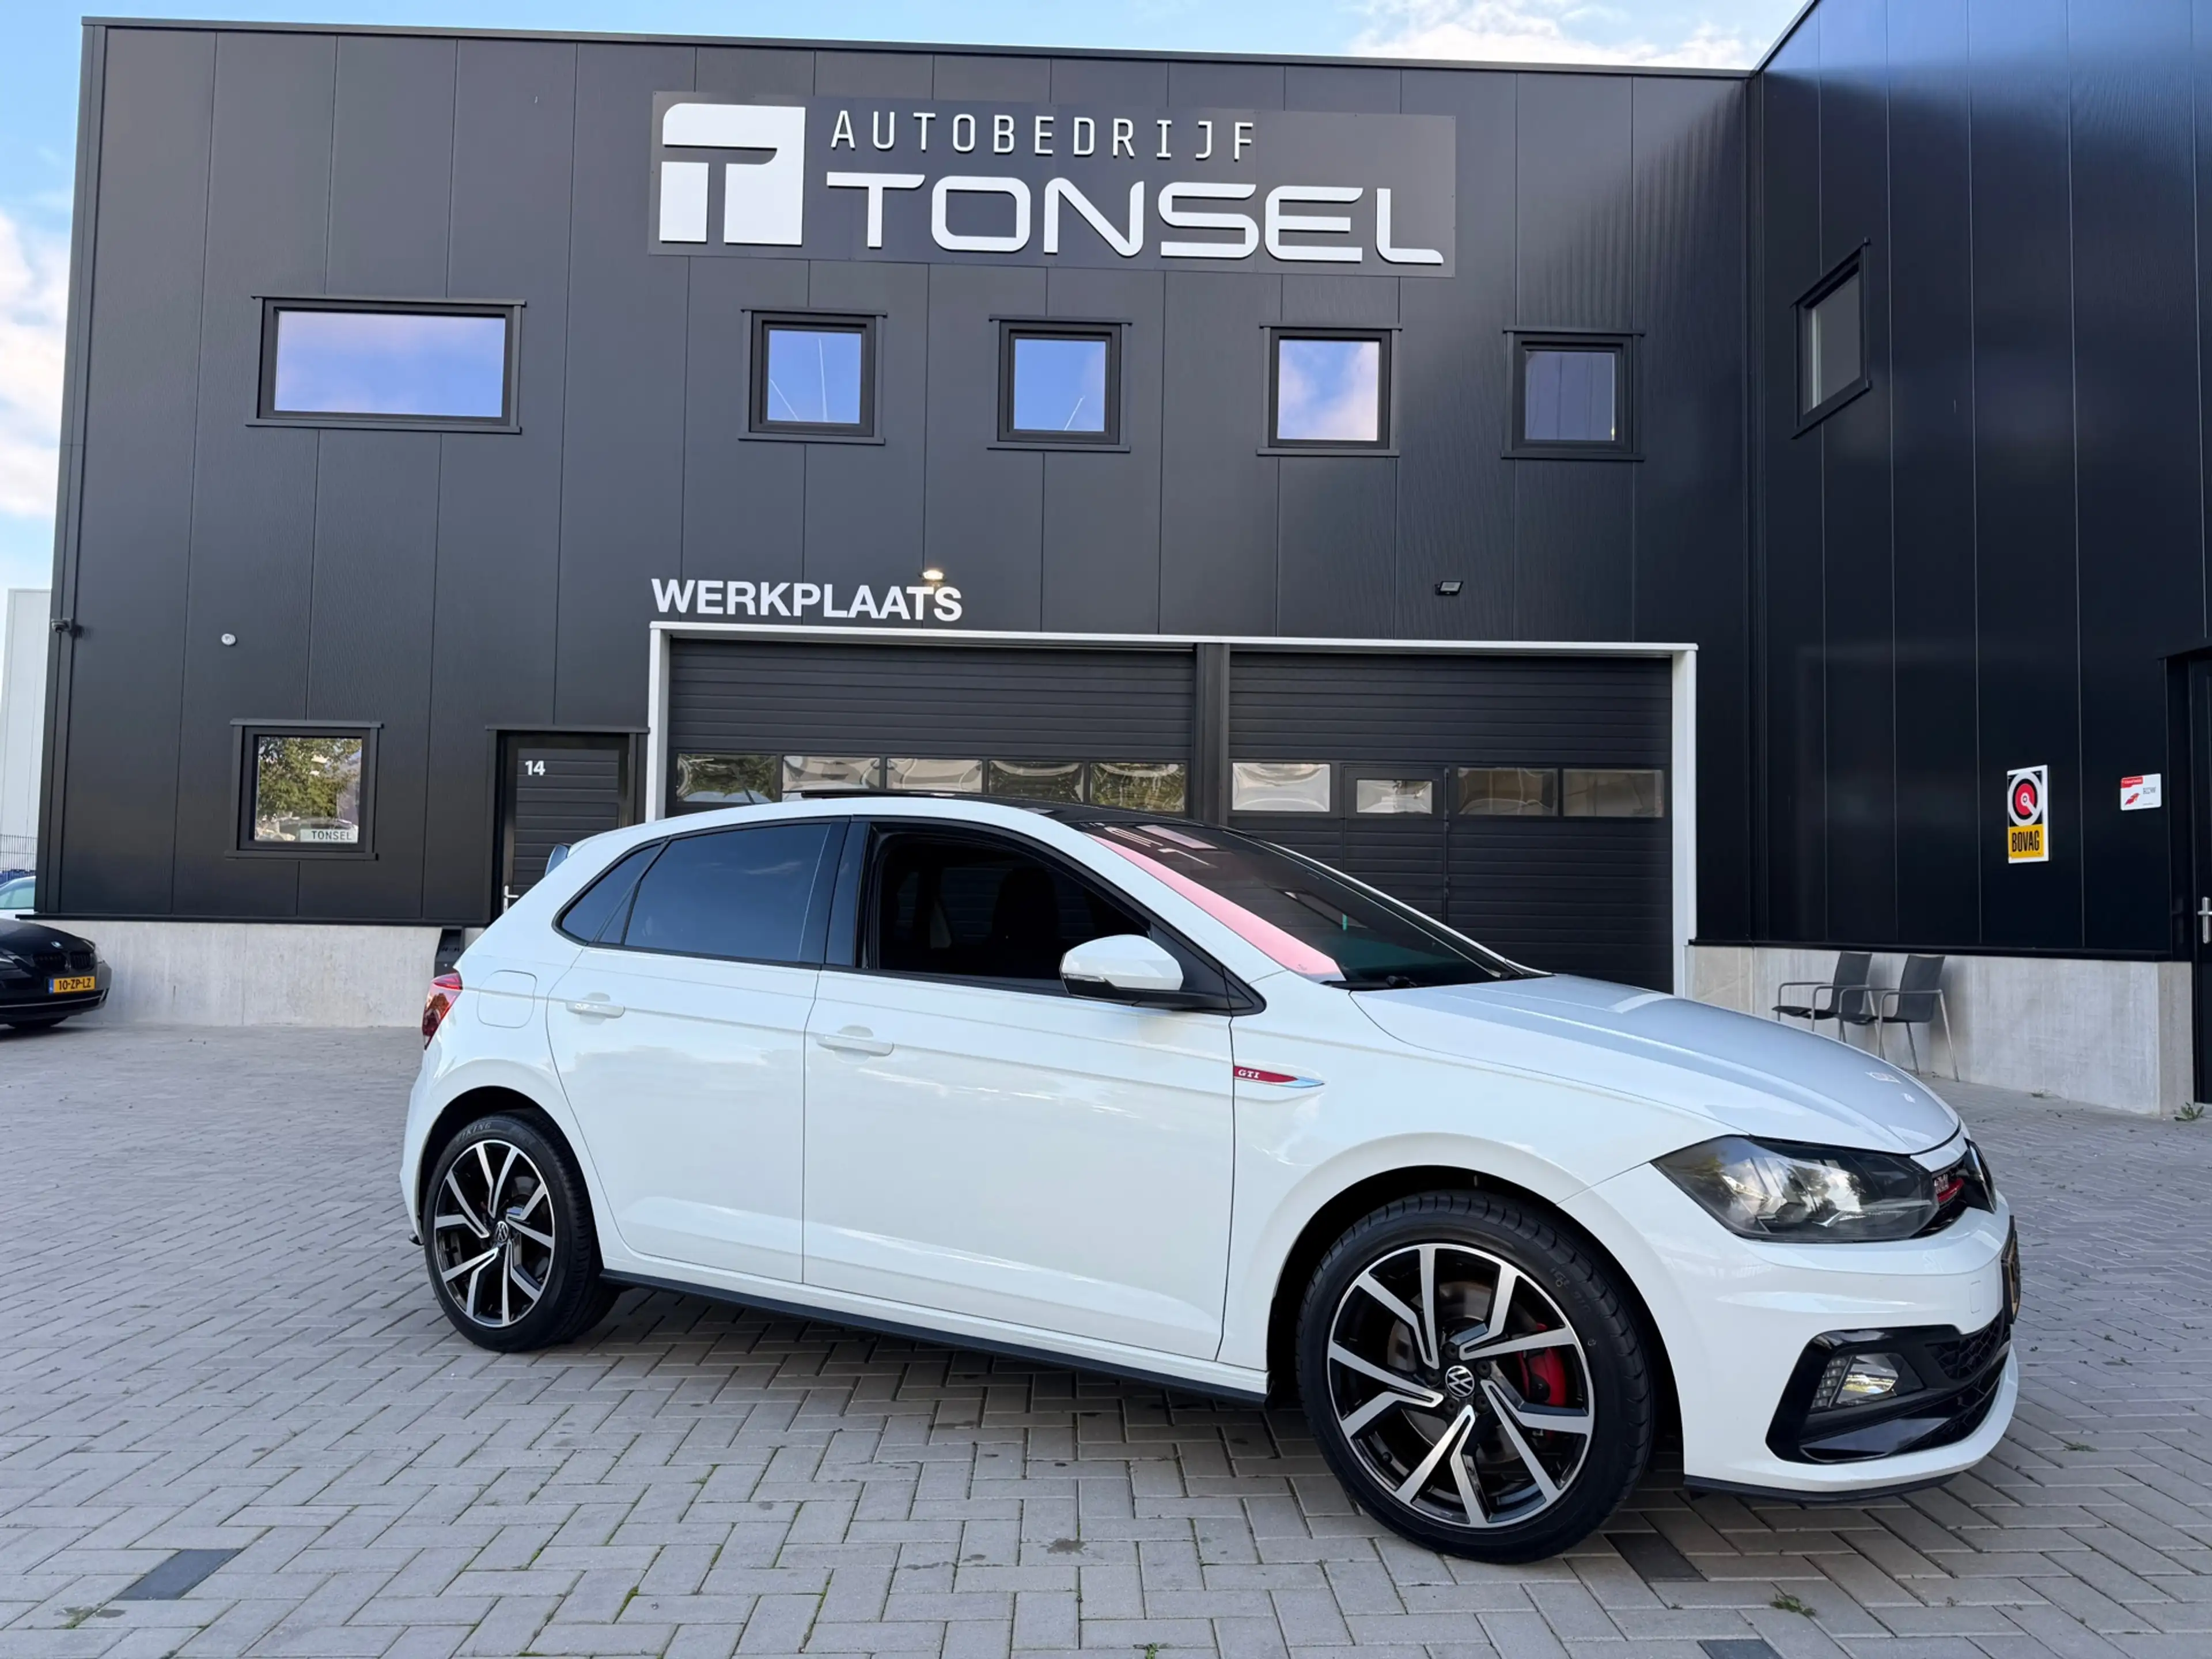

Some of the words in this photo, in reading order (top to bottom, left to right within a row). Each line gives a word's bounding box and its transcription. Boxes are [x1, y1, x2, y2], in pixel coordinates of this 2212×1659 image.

[831, 110, 1254, 160] AUTOBEDRIJF
[826, 171, 1445, 264] TONSEL
[650, 578, 963, 622] WERKPLAATS
[525, 760, 546, 776] 14
[311, 830, 352, 841] TONSEL
[2012, 830, 2040, 853] BOVAG
[58, 978, 92, 990] 10-ZP-LZ
[1237, 1069, 1260, 1080] GTI
